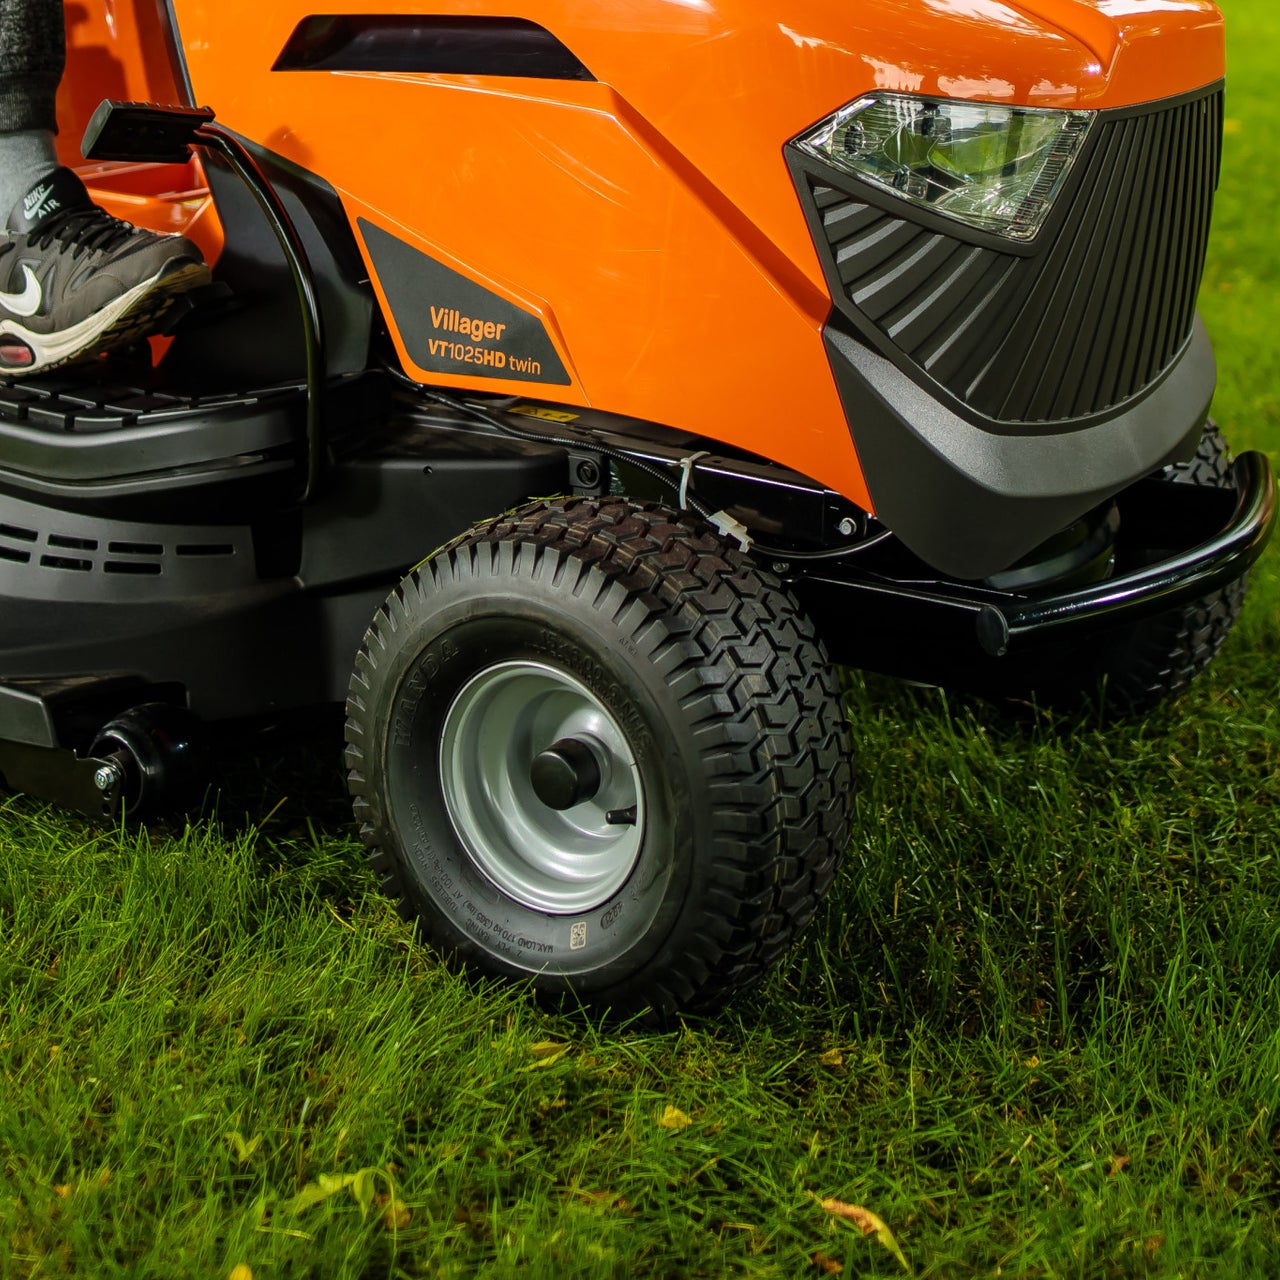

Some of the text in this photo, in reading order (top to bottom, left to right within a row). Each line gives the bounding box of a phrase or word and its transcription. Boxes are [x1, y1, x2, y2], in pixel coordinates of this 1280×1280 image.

[23, 183, 45, 210] NIKE
[38, 199, 60, 219] AIR
[430, 305, 506, 342] Villager
[428, 338, 541, 375] VT1025HD twin
[431, 875, 459, 914] TUBELESS
